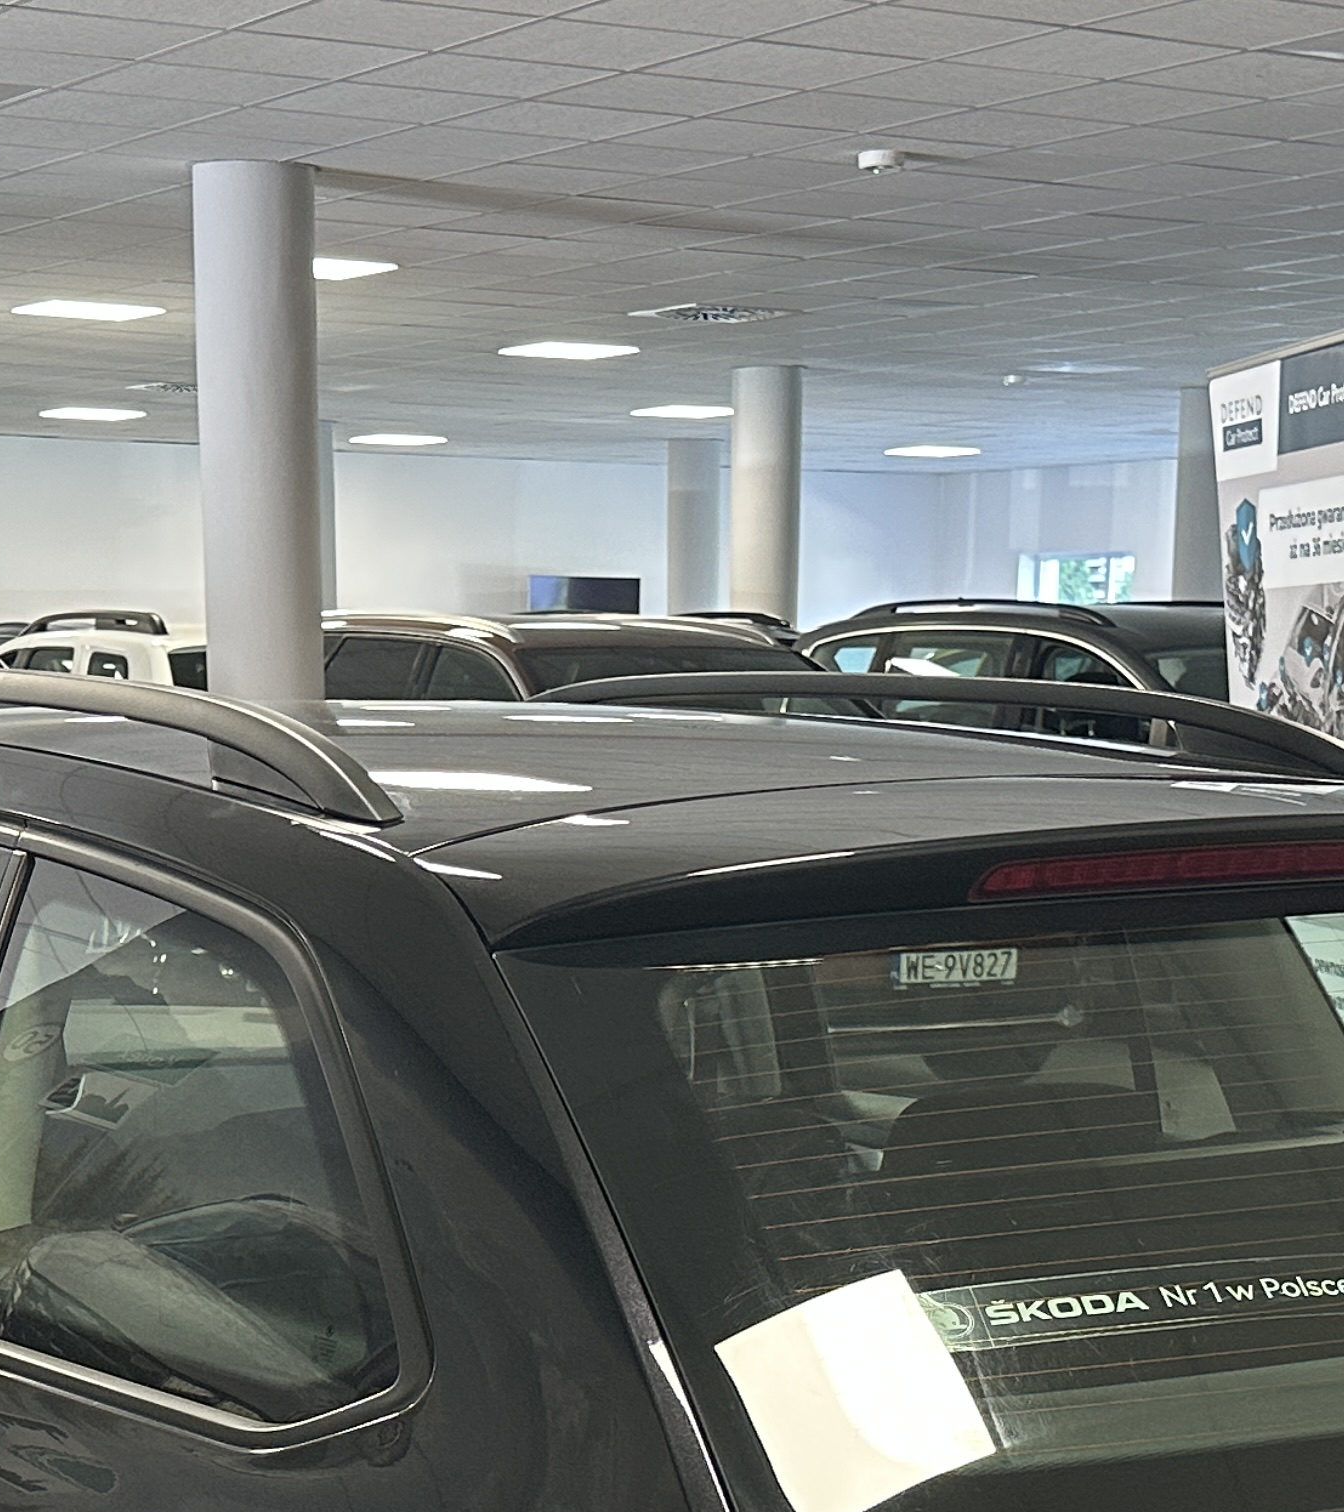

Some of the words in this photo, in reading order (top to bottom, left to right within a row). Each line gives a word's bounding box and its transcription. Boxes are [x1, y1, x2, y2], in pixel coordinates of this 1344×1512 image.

[1221, 394, 1262, 424] DEFEND
[905, 955, 935, 980] WE
[944, 951, 1012, 979] 9V827
[985, 1289, 1149, 1327] ŠKODA
[1159, 1284, 1198, 1308] Nr
[1205, 1281, 1223, 1304] 1
[1226, 1283, 1254, 1302] w
